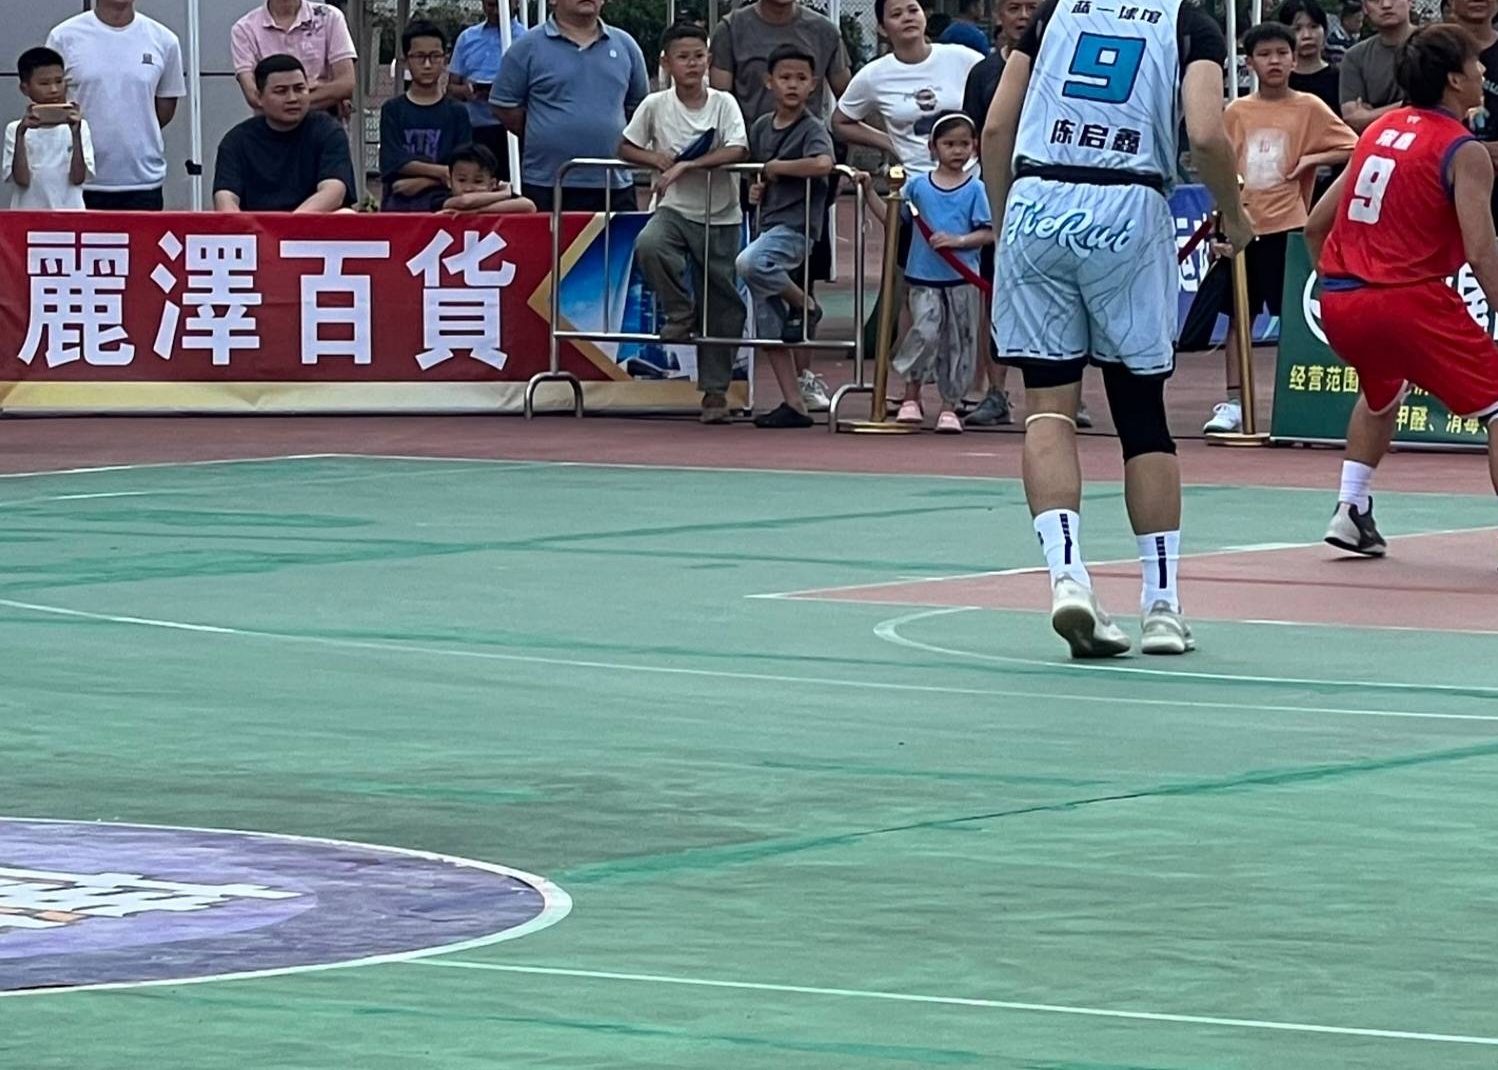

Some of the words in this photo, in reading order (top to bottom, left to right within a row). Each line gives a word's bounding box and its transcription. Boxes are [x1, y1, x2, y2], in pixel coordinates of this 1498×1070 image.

[1062, 31, 1147, 104] 9
[1347, 154, 1396, 224] 9
[18, 229, 516, 370] 麗澤百貨
[1289, 364, 1359, 394] 经营范围
